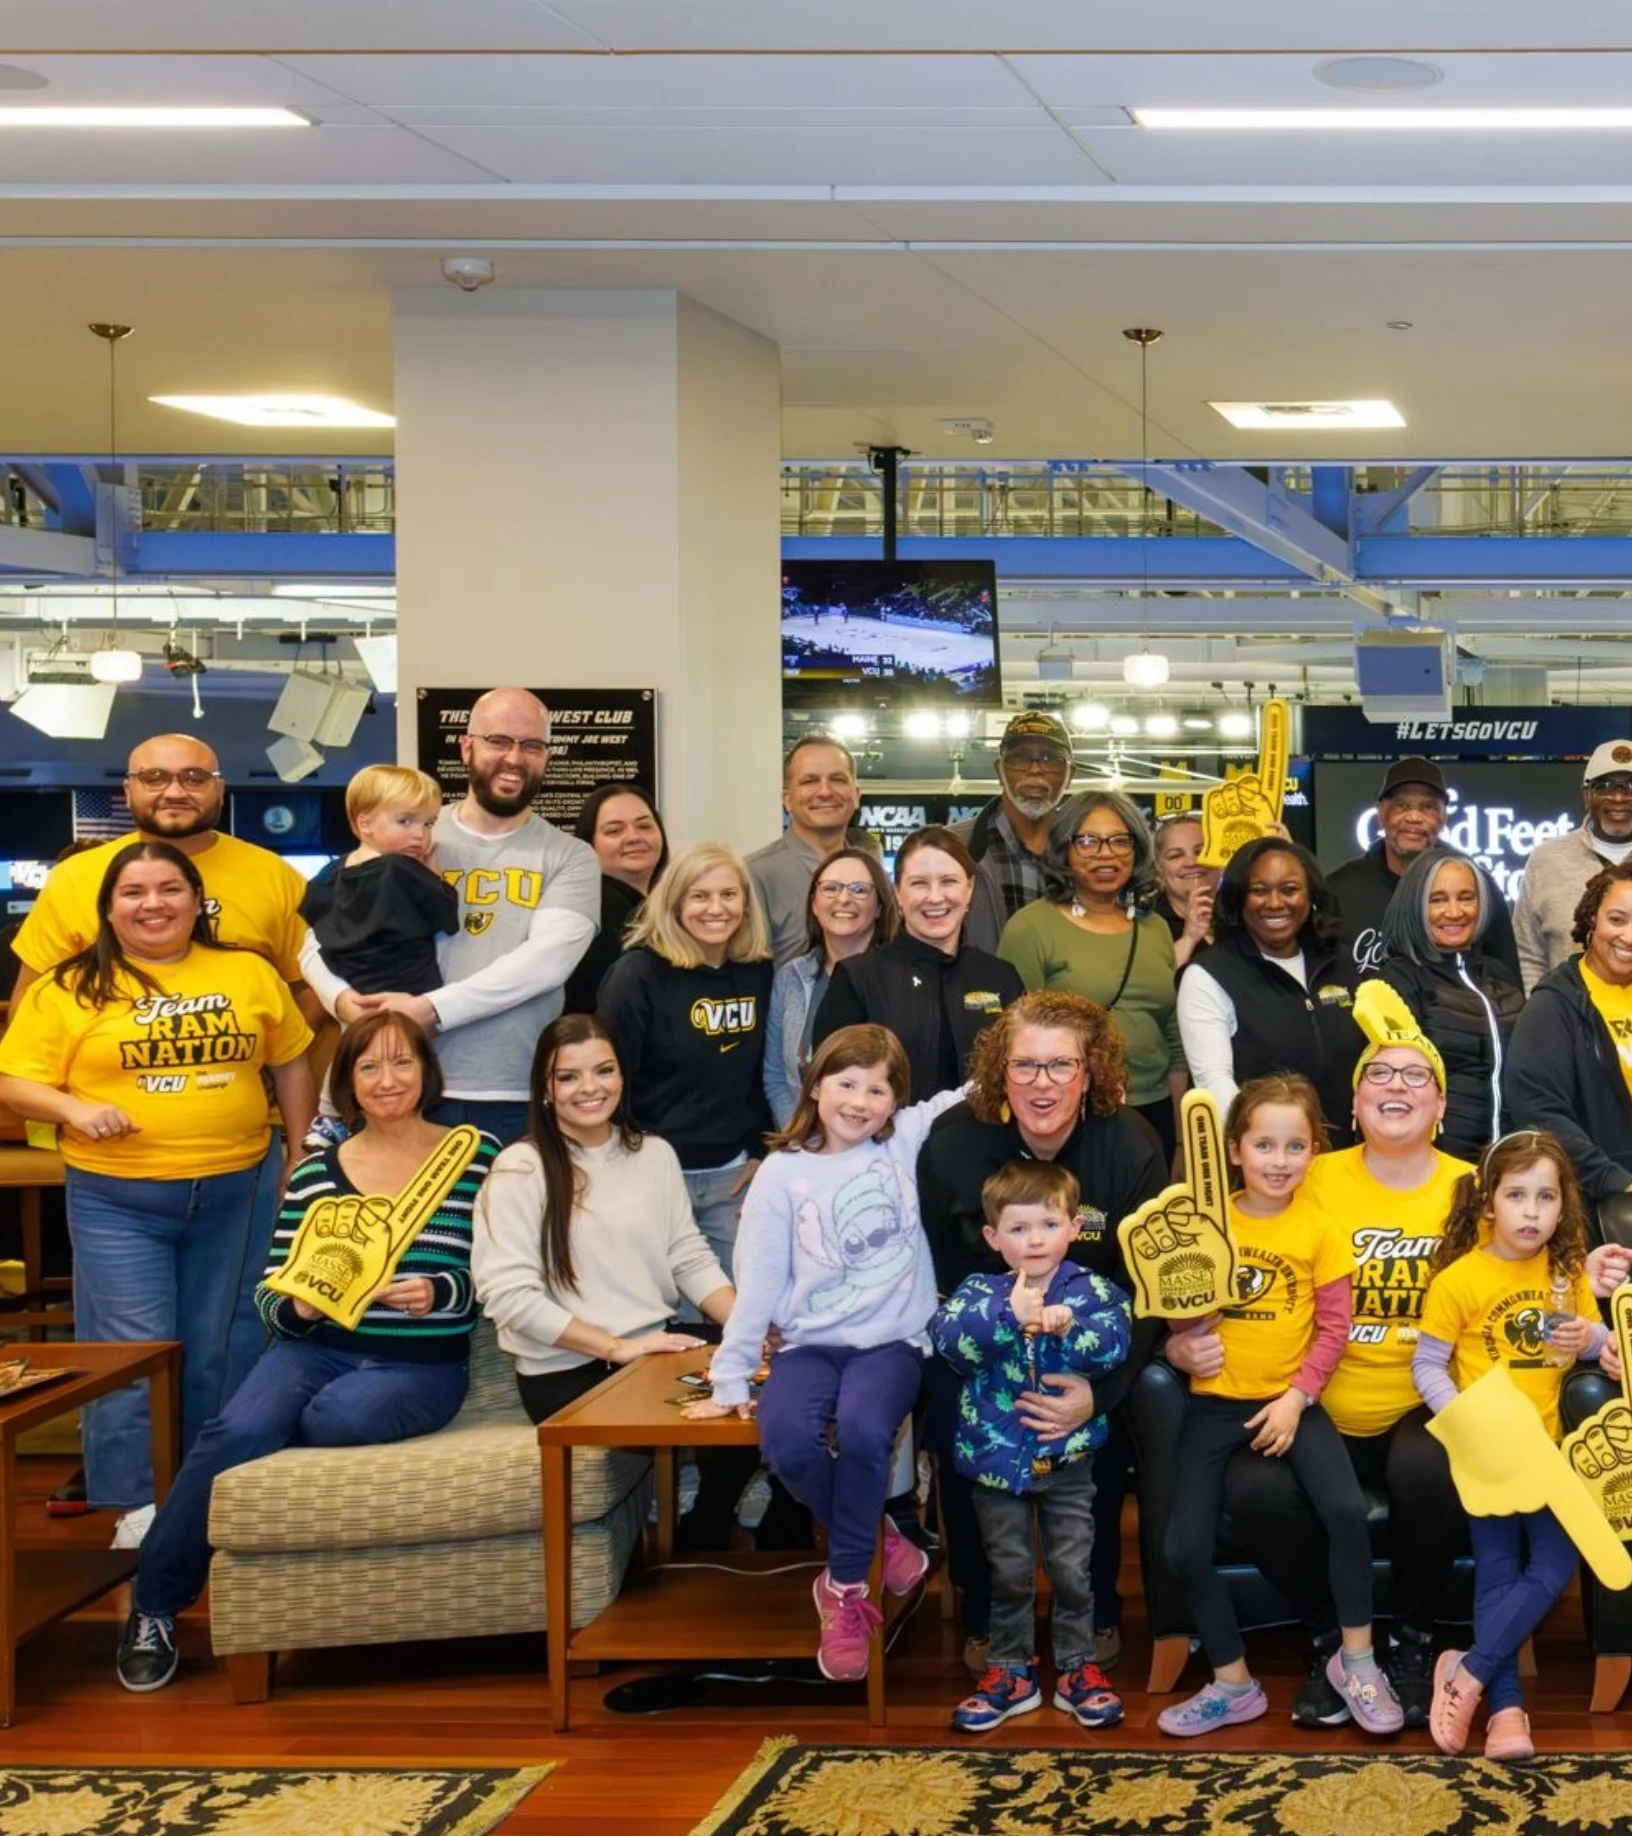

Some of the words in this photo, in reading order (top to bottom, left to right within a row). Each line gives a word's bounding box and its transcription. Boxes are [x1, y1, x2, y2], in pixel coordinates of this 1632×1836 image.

[862, 667, 880, 675] VCU
[440, 710, 470, 724] THE
[549, 710, 593, 724] WEST
[594, 710, 633, 724] CLUB
[445, 735, 457, 743] IN
[601, 735, 629, 744] WEST
[859, 806, 926, 827] NCAA
[946, 806, 983, 825] NC
[1355, 804, 1482, 856] Gd
[1484, 807, 1575, 856] Feet
[1474, 854, 1527, 902] Sto
[135, 993, 230, 1026] Team
[703, 997, 757, 1035] VCU
[150, 1010, 241, 1040] RAM
[120, 1034, 257, 1070] NATION
[145, 1075, 188, 1094] VCU
[1196, 1115, 1206, 1133] ONE
[447, 1140, 463, 1156] ONE
[1199, 1135, 1209, 1159] TEAM
[430, 1158, 451, 1179] TEAM
[1202, 1162, 1211, 1179] ONE
[416, 1181, 432, 1197] ONE
[1204, 1181, 1214, 1207] FIGHT
[398, 1198, 418, 1223] FIGHT
[1353, 1227, 1444, 1266] Team
[308, 1275, 345, 1303] VCU
[1159, 1270, 1214, 1287] MASSEY
[1177, 1289, 1215, 1309] VCU
[1353, 1288, 1425, 1319] ATI
[1487, 1289, 1545, 1323] COMMONWEA
[1350, 1323, 1388, 1344] VCU
